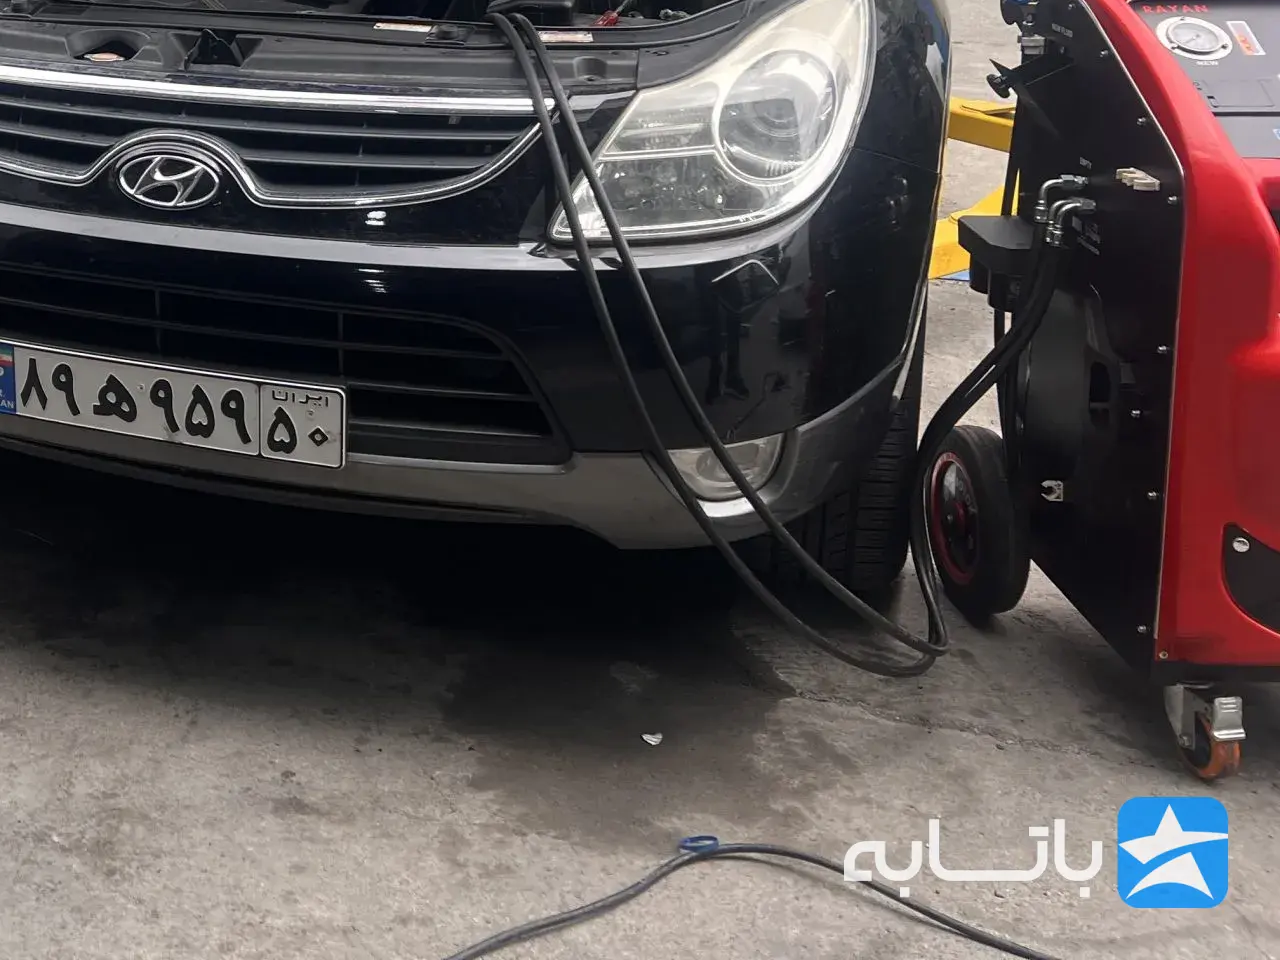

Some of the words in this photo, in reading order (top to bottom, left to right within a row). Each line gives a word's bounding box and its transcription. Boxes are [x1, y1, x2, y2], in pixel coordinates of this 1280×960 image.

[1142, 5, 1209, 13] RAYAN
[271, 389, 329, 407] ایران
[267, 406, 329, 454] ۵۰
